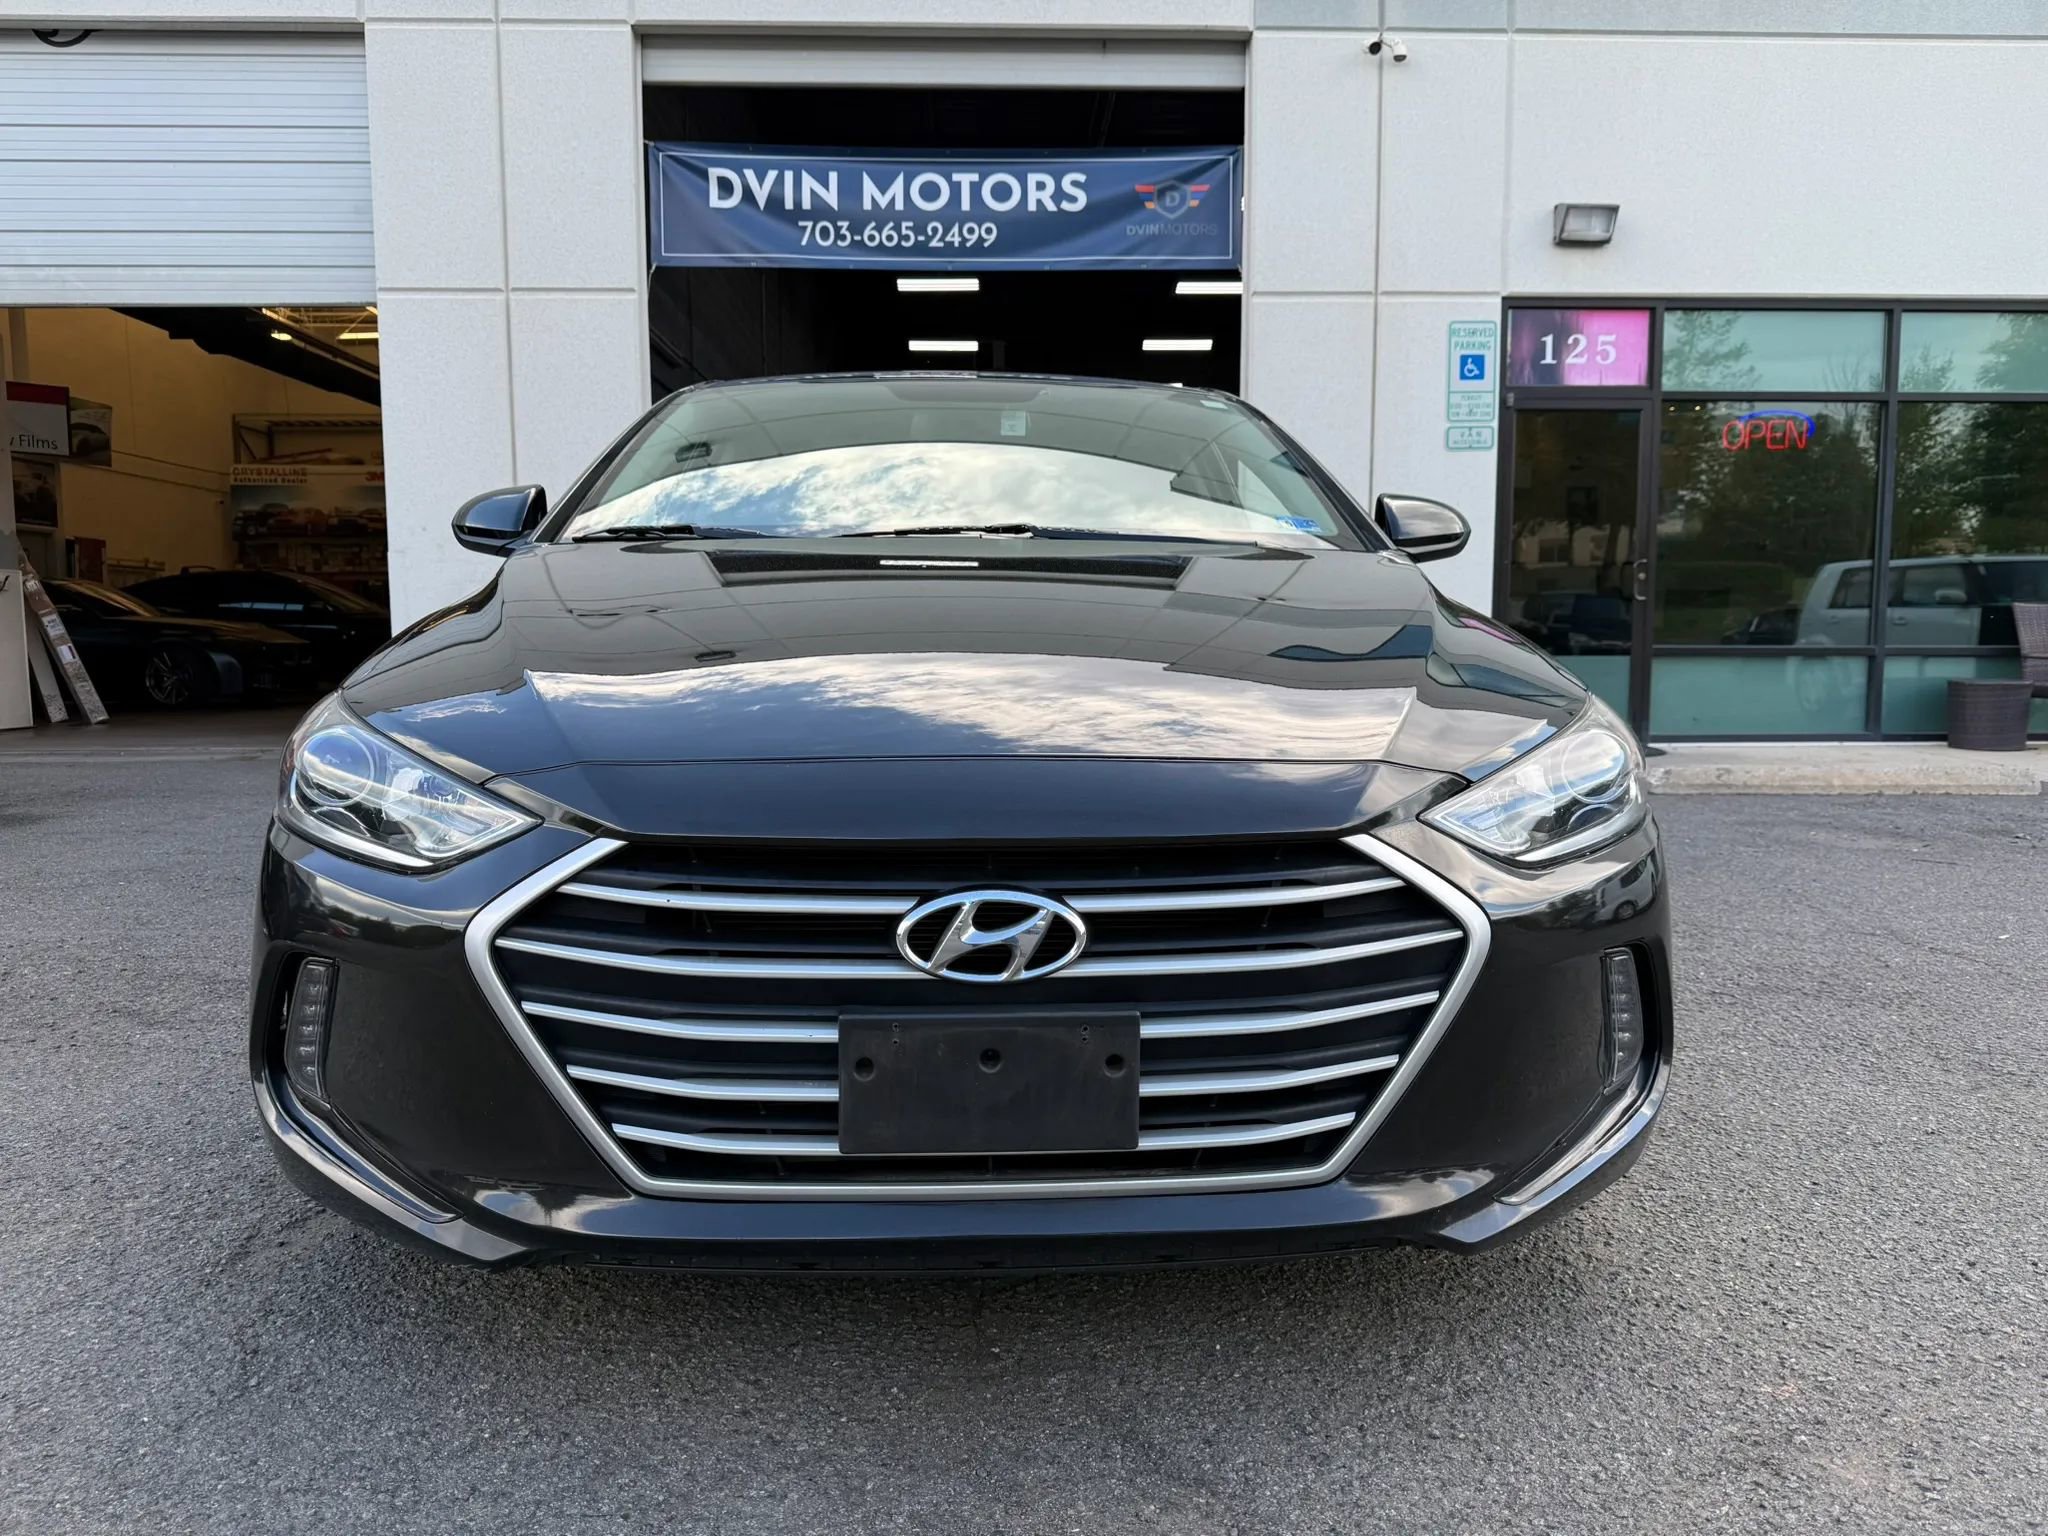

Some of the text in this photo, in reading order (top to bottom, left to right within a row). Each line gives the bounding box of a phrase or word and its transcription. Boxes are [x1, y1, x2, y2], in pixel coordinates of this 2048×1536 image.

[707, 167, 1088, 212] DVIN MOTORS
[798, 220, 998, 248] 703-665-2499
[1451, 327, 1494, 338] RESERVED
[1454, 340, 1491, 350] PARKING
[1539, 333, 1617, 365] 125
[18, 434, 58, 450] Films
[1722, 418, 1808, 451] OPEN
